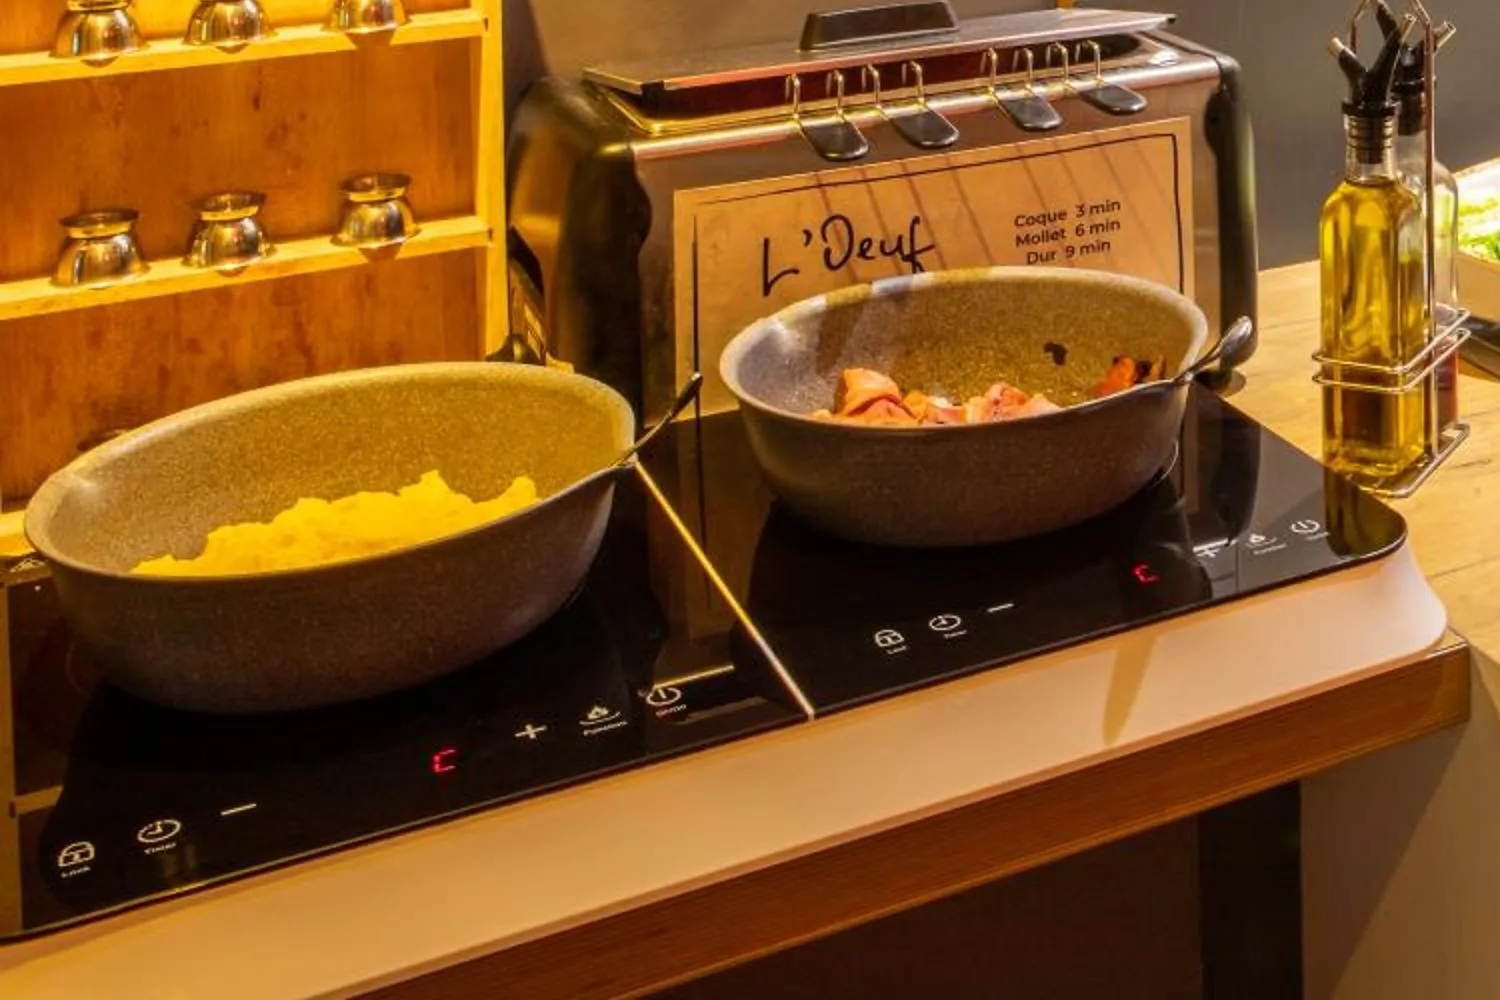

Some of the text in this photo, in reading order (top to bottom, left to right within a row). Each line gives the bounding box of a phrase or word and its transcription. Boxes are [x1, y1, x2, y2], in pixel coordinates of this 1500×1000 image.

[1014, 199, 1121, 228] Coque 3 min
[1015, 219, 1121, 248] Mollet 6 min
[1027, 239, 1111, 266] Dur 9 min
